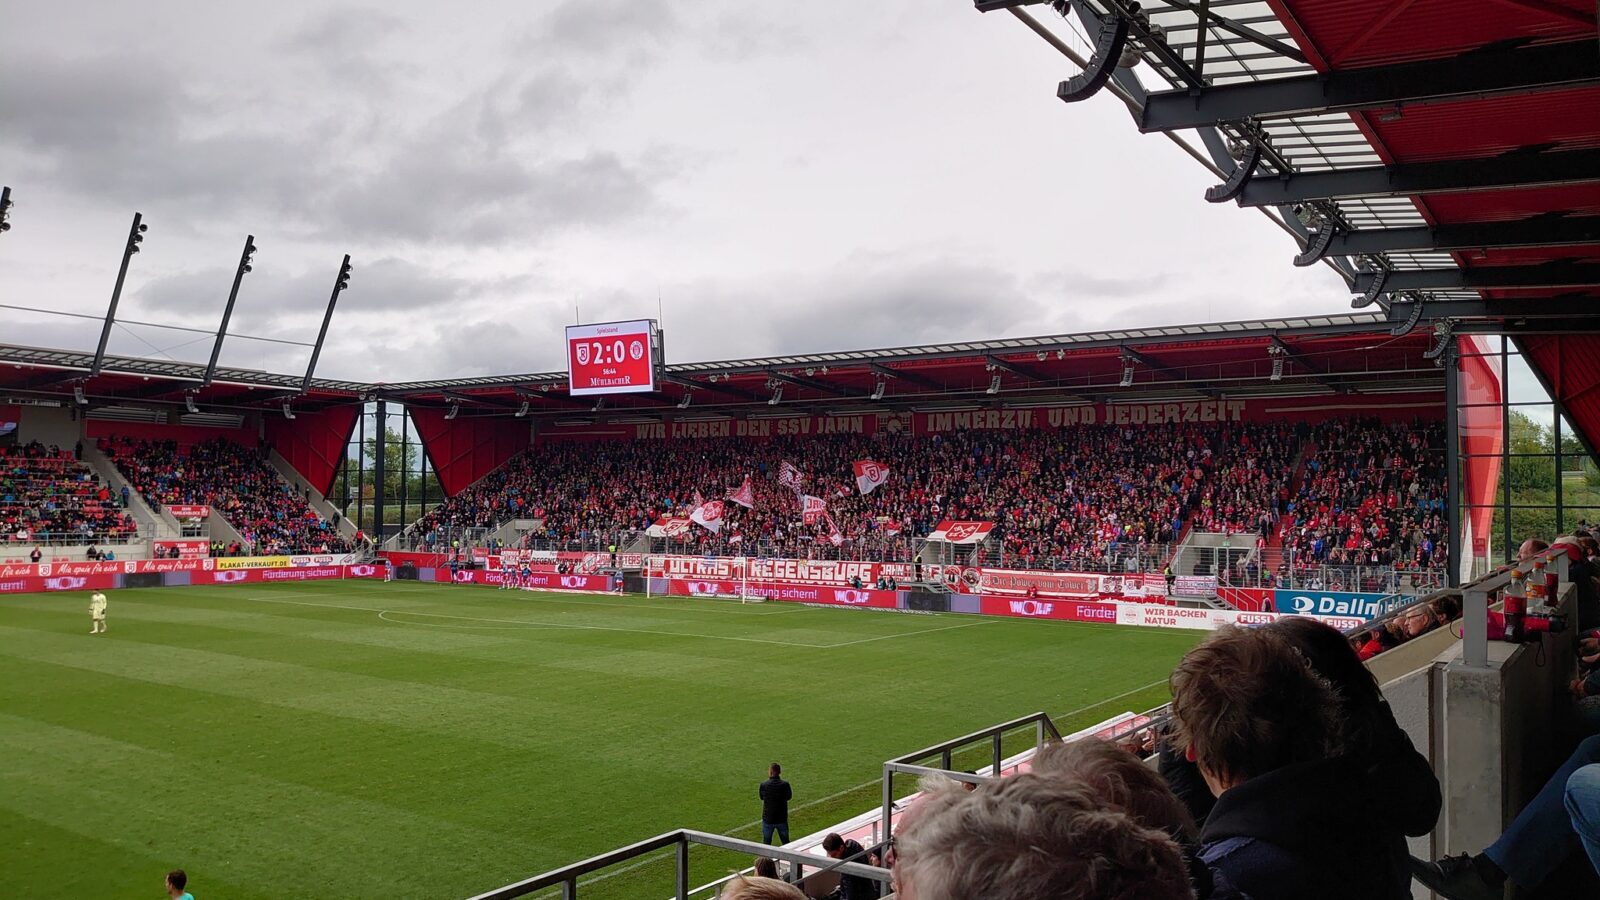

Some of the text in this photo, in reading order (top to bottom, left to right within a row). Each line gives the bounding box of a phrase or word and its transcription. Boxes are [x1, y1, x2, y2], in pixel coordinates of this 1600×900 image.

[593, 341, 625, 364] 2:0
[927, 400, 1246, 432] IMMERZU UND JEDERZEIT
[637, 415, 864, 440] WIR LIEBEN DEN SSV JAHN
[220, 561, 287, 569] PLAKAT-VERKAUFT.DE
[751, 560, 872, 584] REGENSBURG
[560, 576, 588, 588] WOLF
[834, 590, 870, 604] WOLF
[1009, 601, 1054, 615] WOLF
[1144, 608, 1165, 617] WIR
[1167, 608, 1207, 619] BACKEN
[1144, 617, 1177, 626] NATUR
